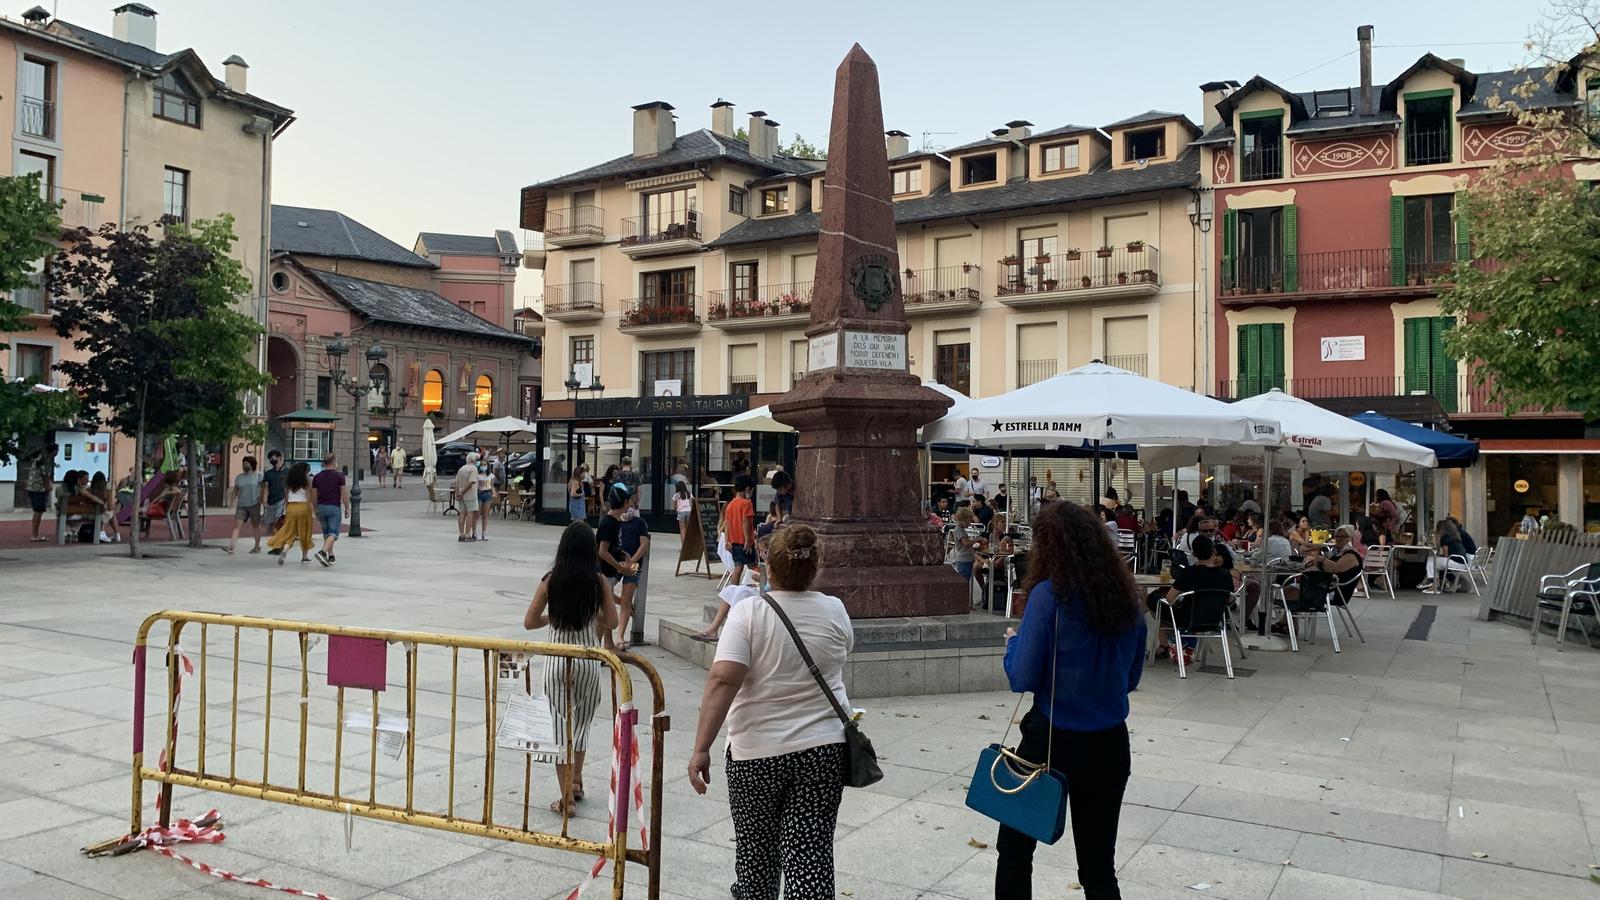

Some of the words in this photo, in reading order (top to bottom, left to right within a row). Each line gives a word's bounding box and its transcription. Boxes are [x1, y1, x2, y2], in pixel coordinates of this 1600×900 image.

[1505, 136, 1527, 145] 1992
[1332, 152, 1351, 160] 1908
[652, 402, 672, 412] BAR
[1005, 422, 1048, 432] ESTRELLA
[1052, 422, 1082, 432] DAMM
[1292, 435, 1322, 446] Estrella
